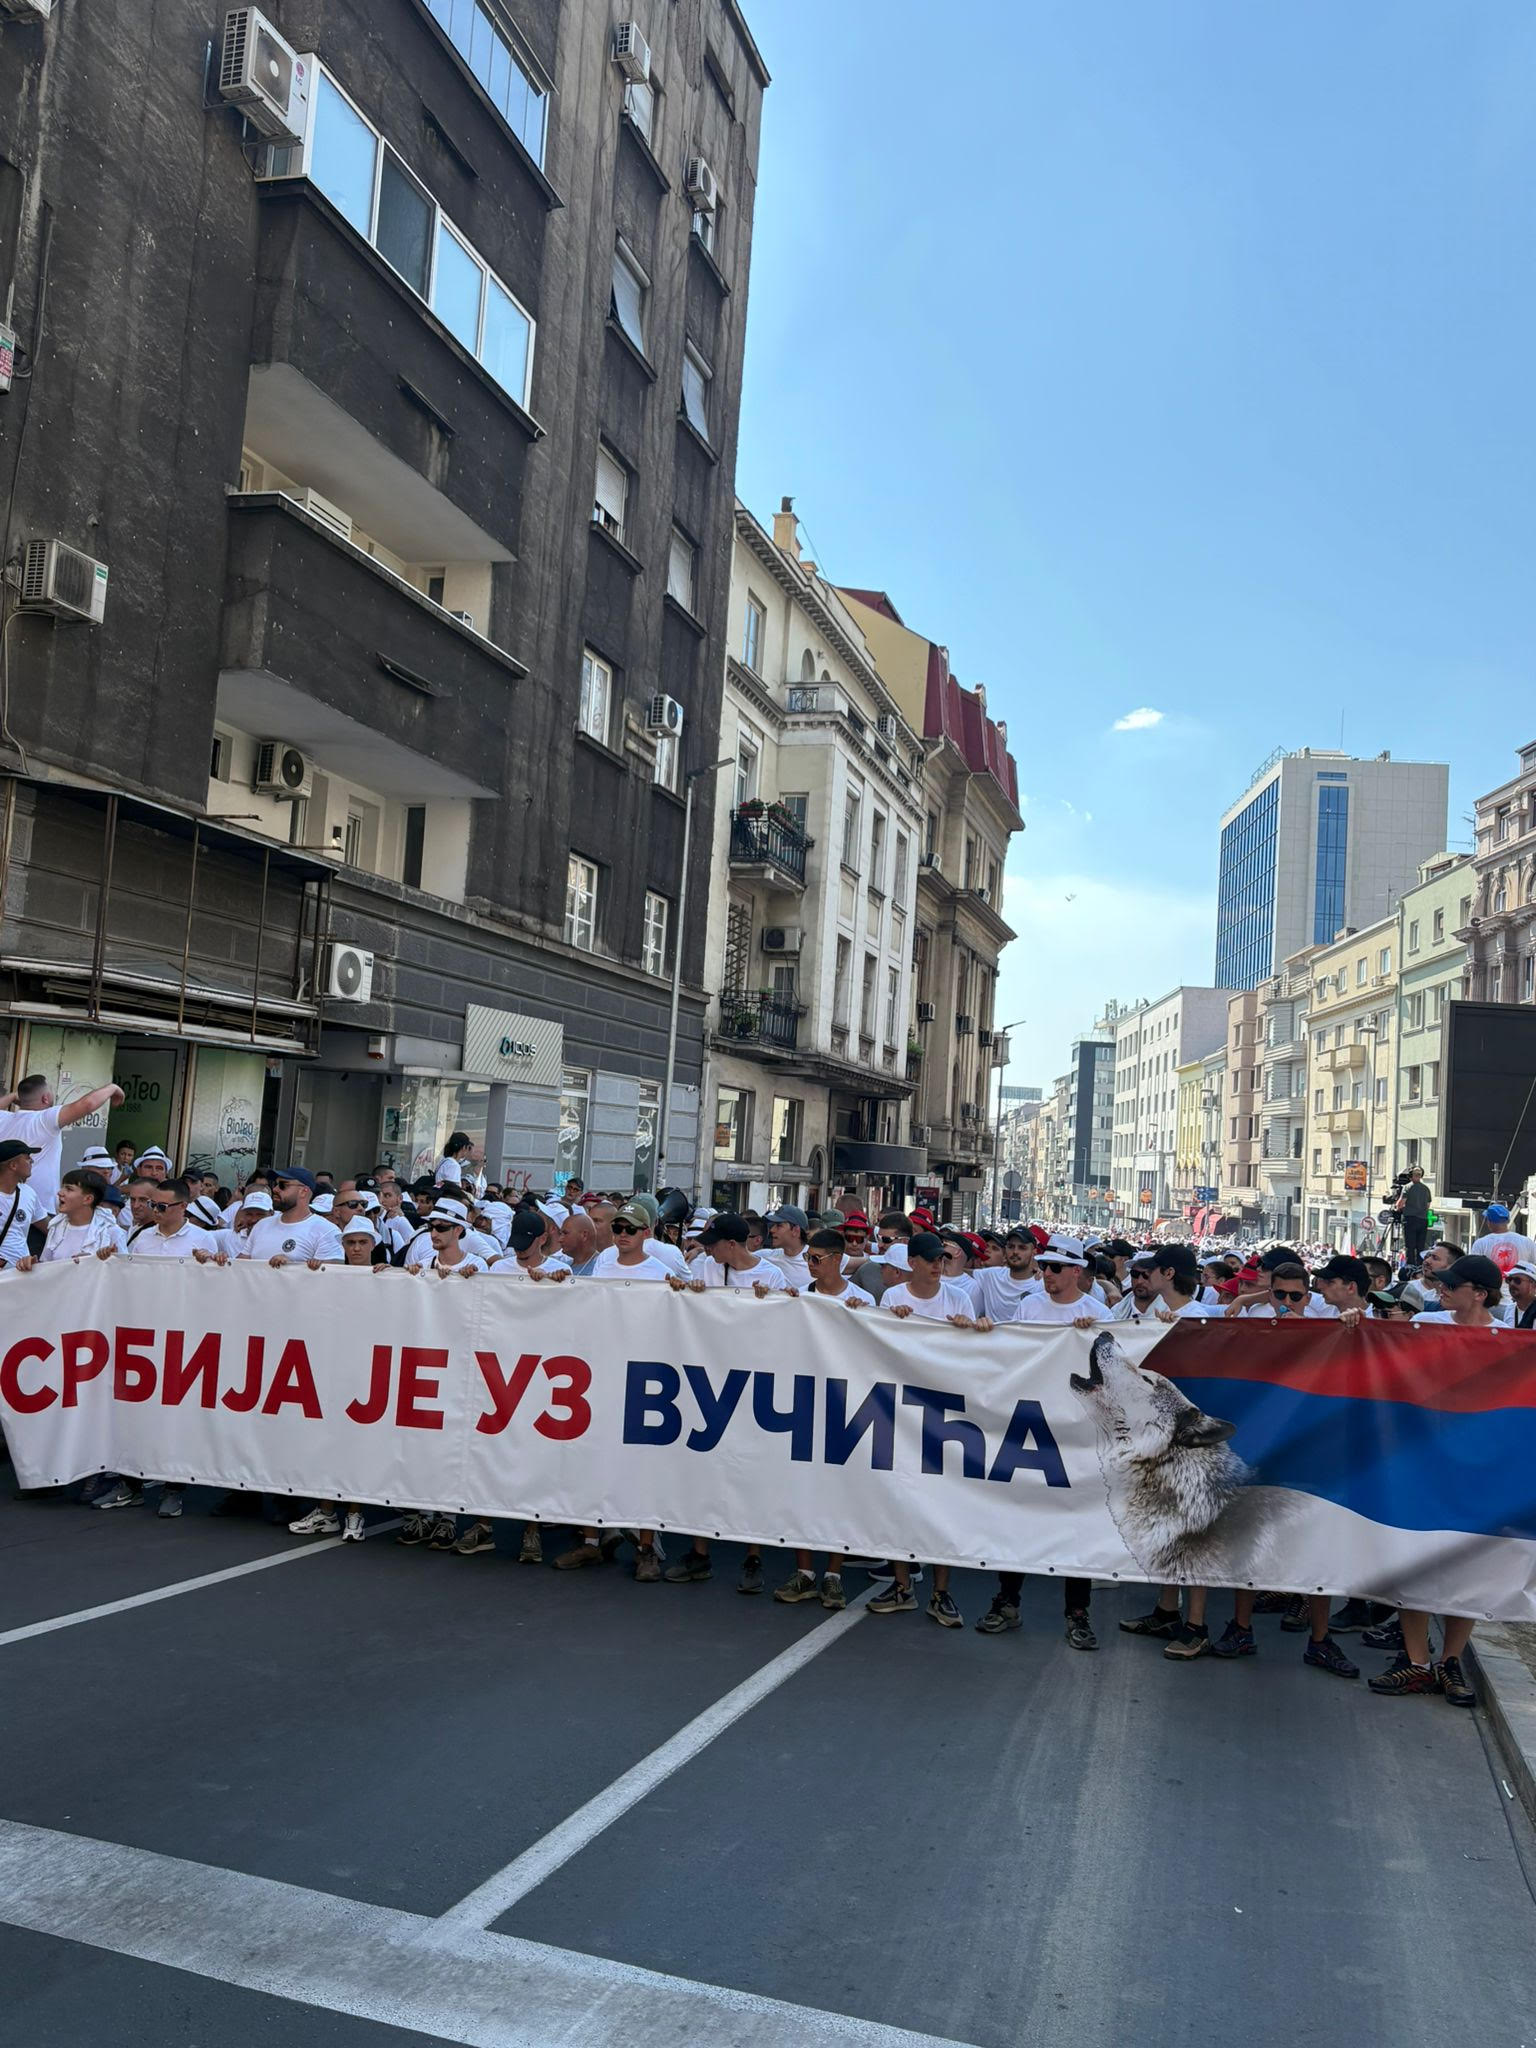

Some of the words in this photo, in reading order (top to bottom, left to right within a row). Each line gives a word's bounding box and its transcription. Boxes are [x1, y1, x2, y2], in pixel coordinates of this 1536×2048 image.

[511, 1040, 538, 1057] IQOS
[226, 1117, 254, 1135] BioTeo
[0, 1327, 323, 1419] СРБИЈА
[345, 1345, 450, 1431] ЈЕ
[475, 1351, 593, 1441] УЗ
[623, 1360, 1071, 1489] ВУЧИЋА
